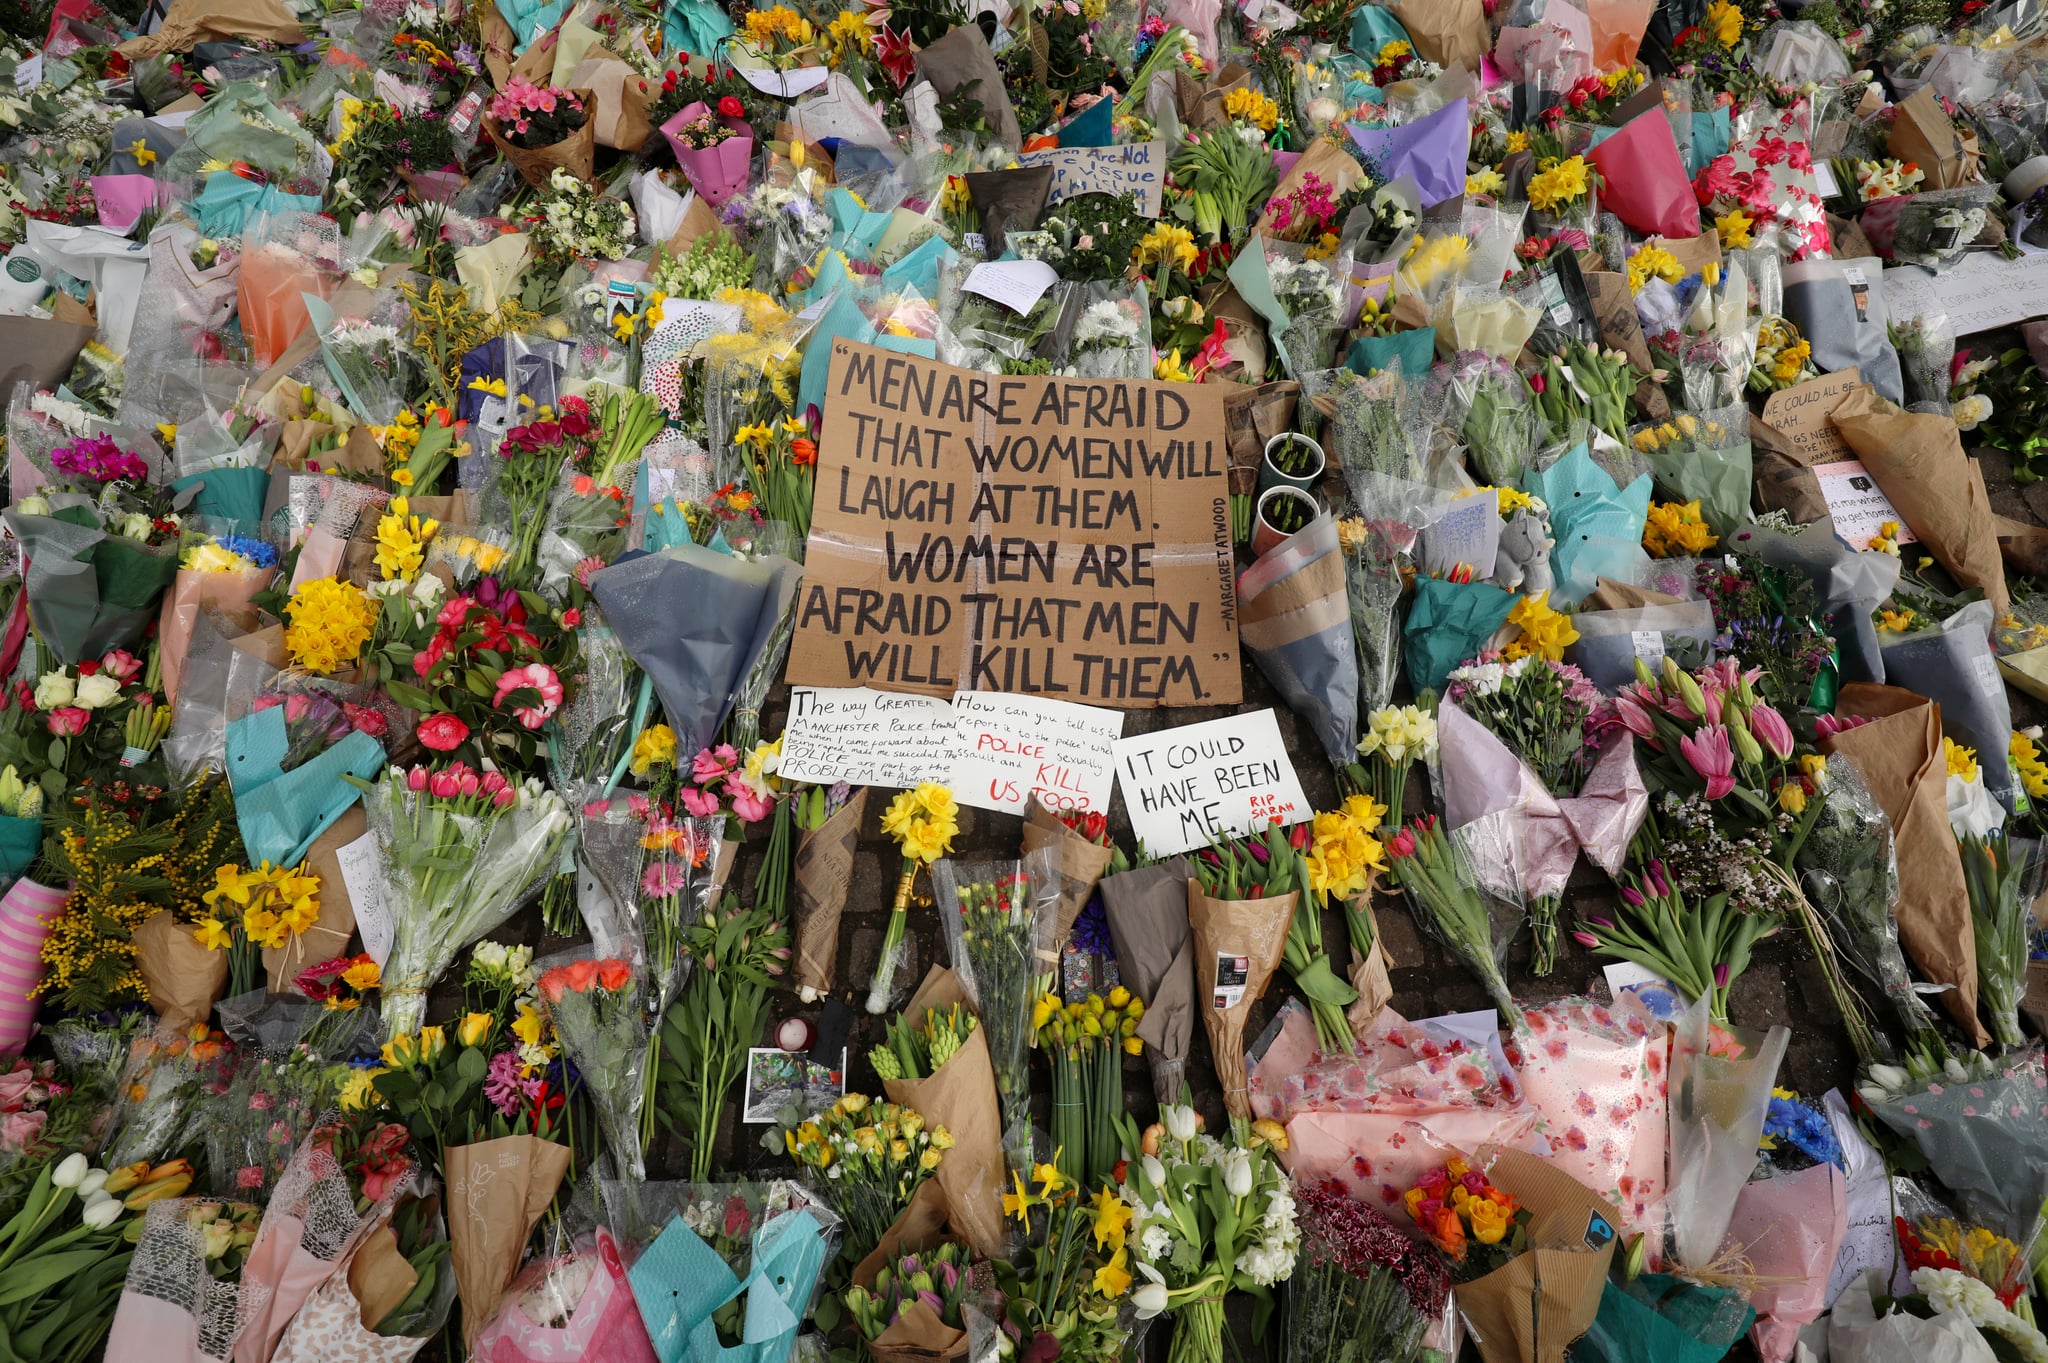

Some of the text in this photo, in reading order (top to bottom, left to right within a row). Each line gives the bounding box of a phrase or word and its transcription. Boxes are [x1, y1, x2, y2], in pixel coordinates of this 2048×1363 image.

[1018, 145, 1151, 165] Womxn Are Not
[937, 374, 1026, 425] ARE
[1032, 381, 1190, 431] AFRAID
[1765, 381, 1855, 416] WE COULD ALL BE
[848, 411, 1222, 481] THAT WOMEN WILL
[839, 465, 1160, 530] LAUGH AT THEM.
[1841, 498, 1857, 509] me
[1858, 494, 1886, 506] when
[1212, 497, 1229, 549] ATWOOD
[1832, 508, 1896, 525] ou get home
[885, 530, 1155, 587] WOMEN ARE
[800, 585, 1199, 646] AFRAID THAT MEN
[844, 640, 953, 685] WILL
[970, 644, 1068, 693] KILL
[793, 691, 834, 716] The
[842, 703, 867, 721] way
[957, 695, 1118, 741] How can you tell us to
[789, 729, 949, 751] me when I came forward about
[793, 718, 880, 734] MANCHESTER
[1004, 724, 1011, 733] it
[1019, 729, 1030, 739] to
[1035, 732, 1049, 743] the
[786, 744, 850, 765] POLICE
[880, 762, 906, 772] part
[910, 765, 924, 777] of
[929, 763, 951, 773] the
[788, 736, 815, 752] being
[943, 749, 958, 760] The
[978, 734, 1046, 759] POLICE
[1057, 752, 1103, 777] sexually
[1126, 737, 1245, 780] IT COULD
[782, 757, 879, 782] PROBLEM.
[958, 749, 1089, 794] ssault and KILL
[1140, 759, 1281, 813] HAVE BEEN
[990, 778, 1091, 811] US TOO?
[1250, 794, 1275, 807] RIP
[1251, 803, 1296, 820] SARAH
